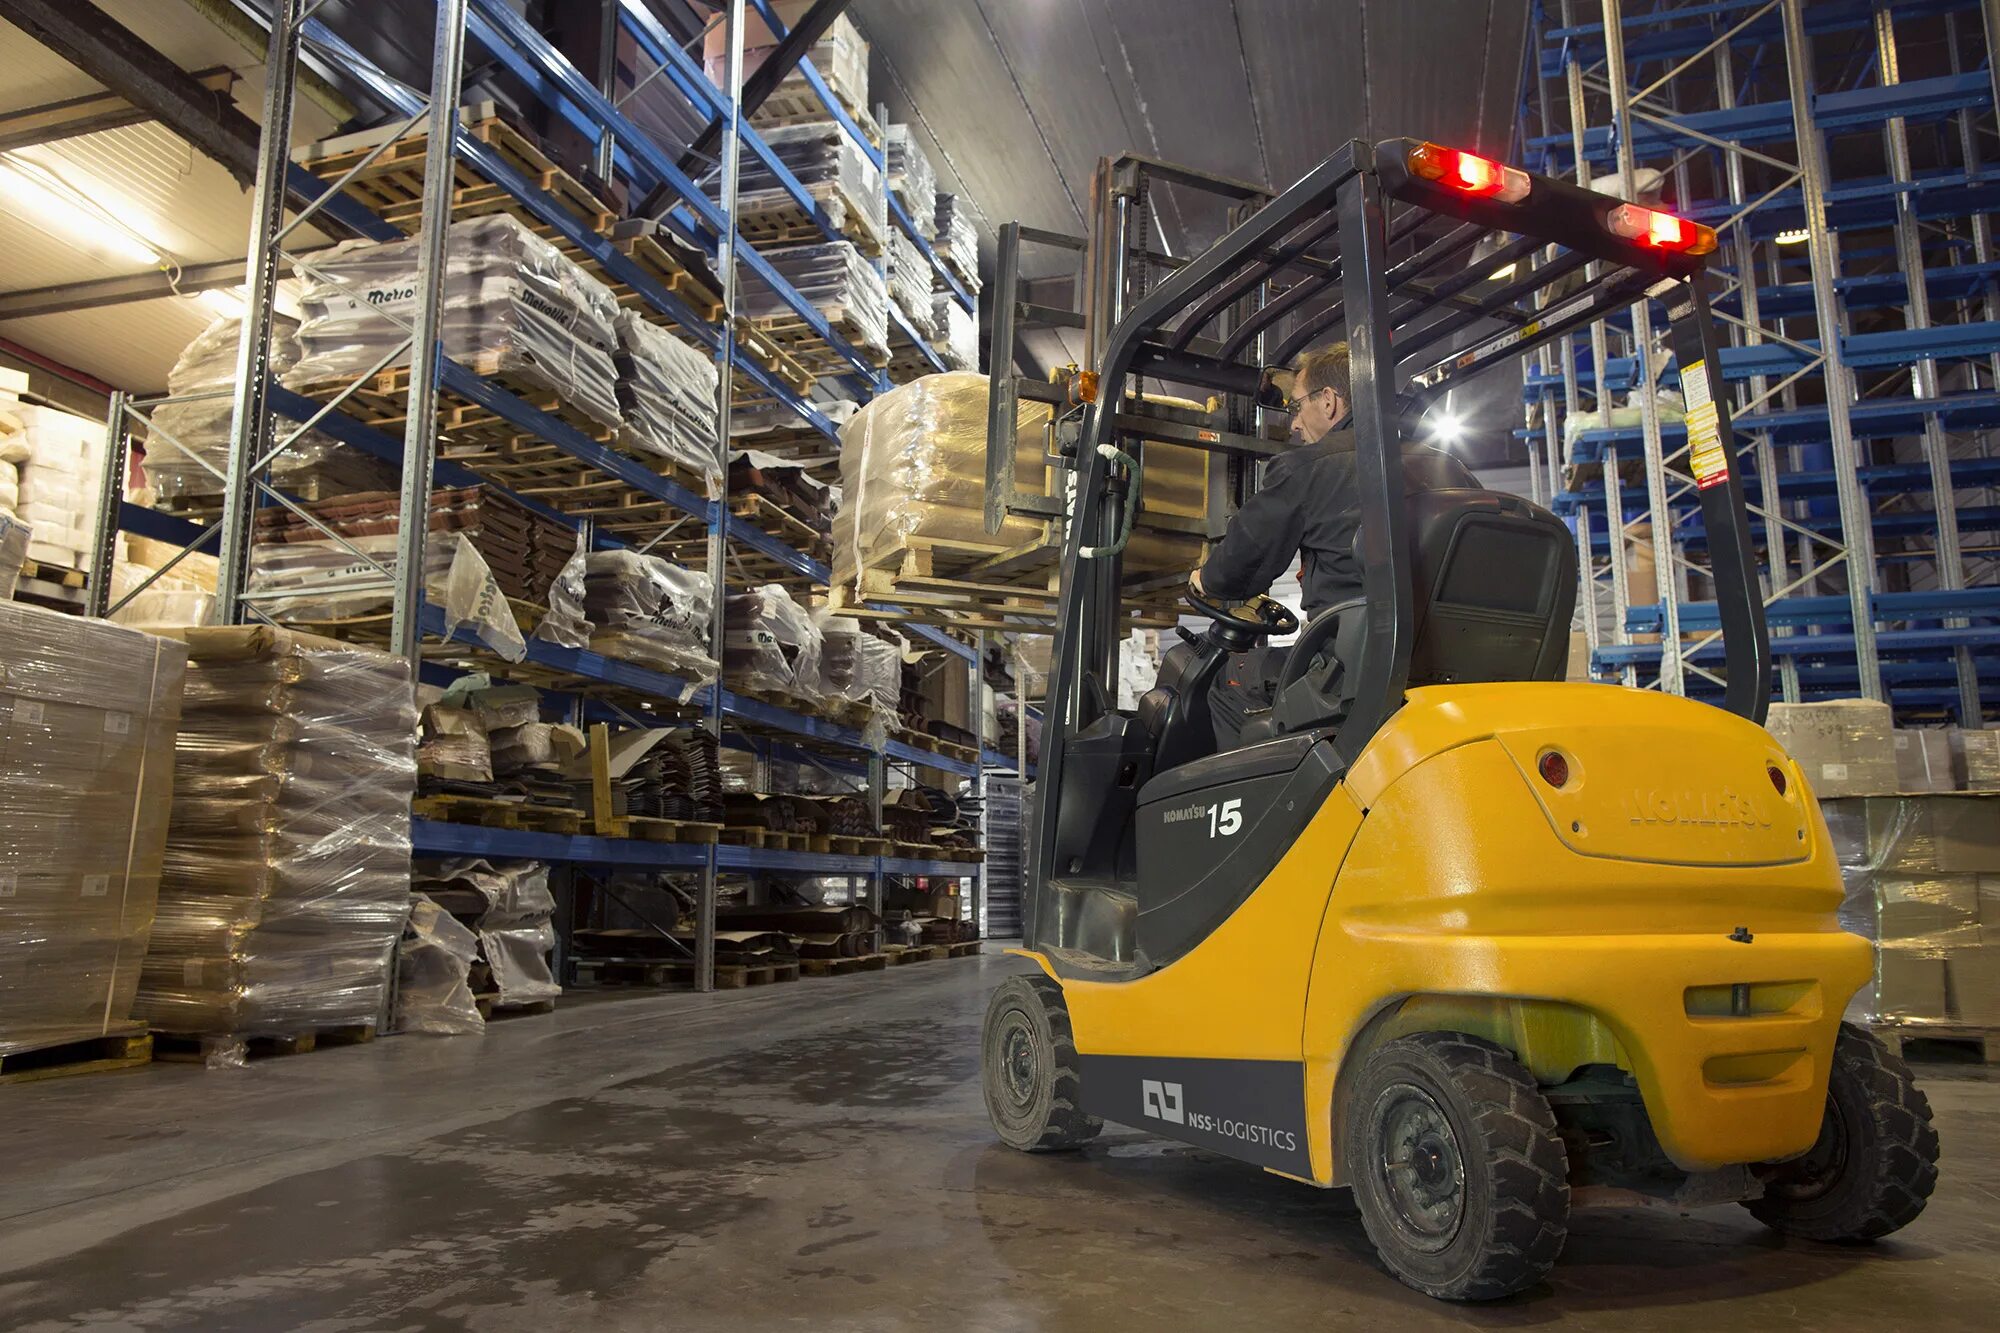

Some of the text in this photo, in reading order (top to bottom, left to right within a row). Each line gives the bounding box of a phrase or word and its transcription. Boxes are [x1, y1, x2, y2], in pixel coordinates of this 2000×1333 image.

[521, 288, 568, 323] Metrotile
[1163, 798, 1242, 838] KOMATSU 15
[1188, 1111, 1296, 1152] NSS-LOGISTICS
